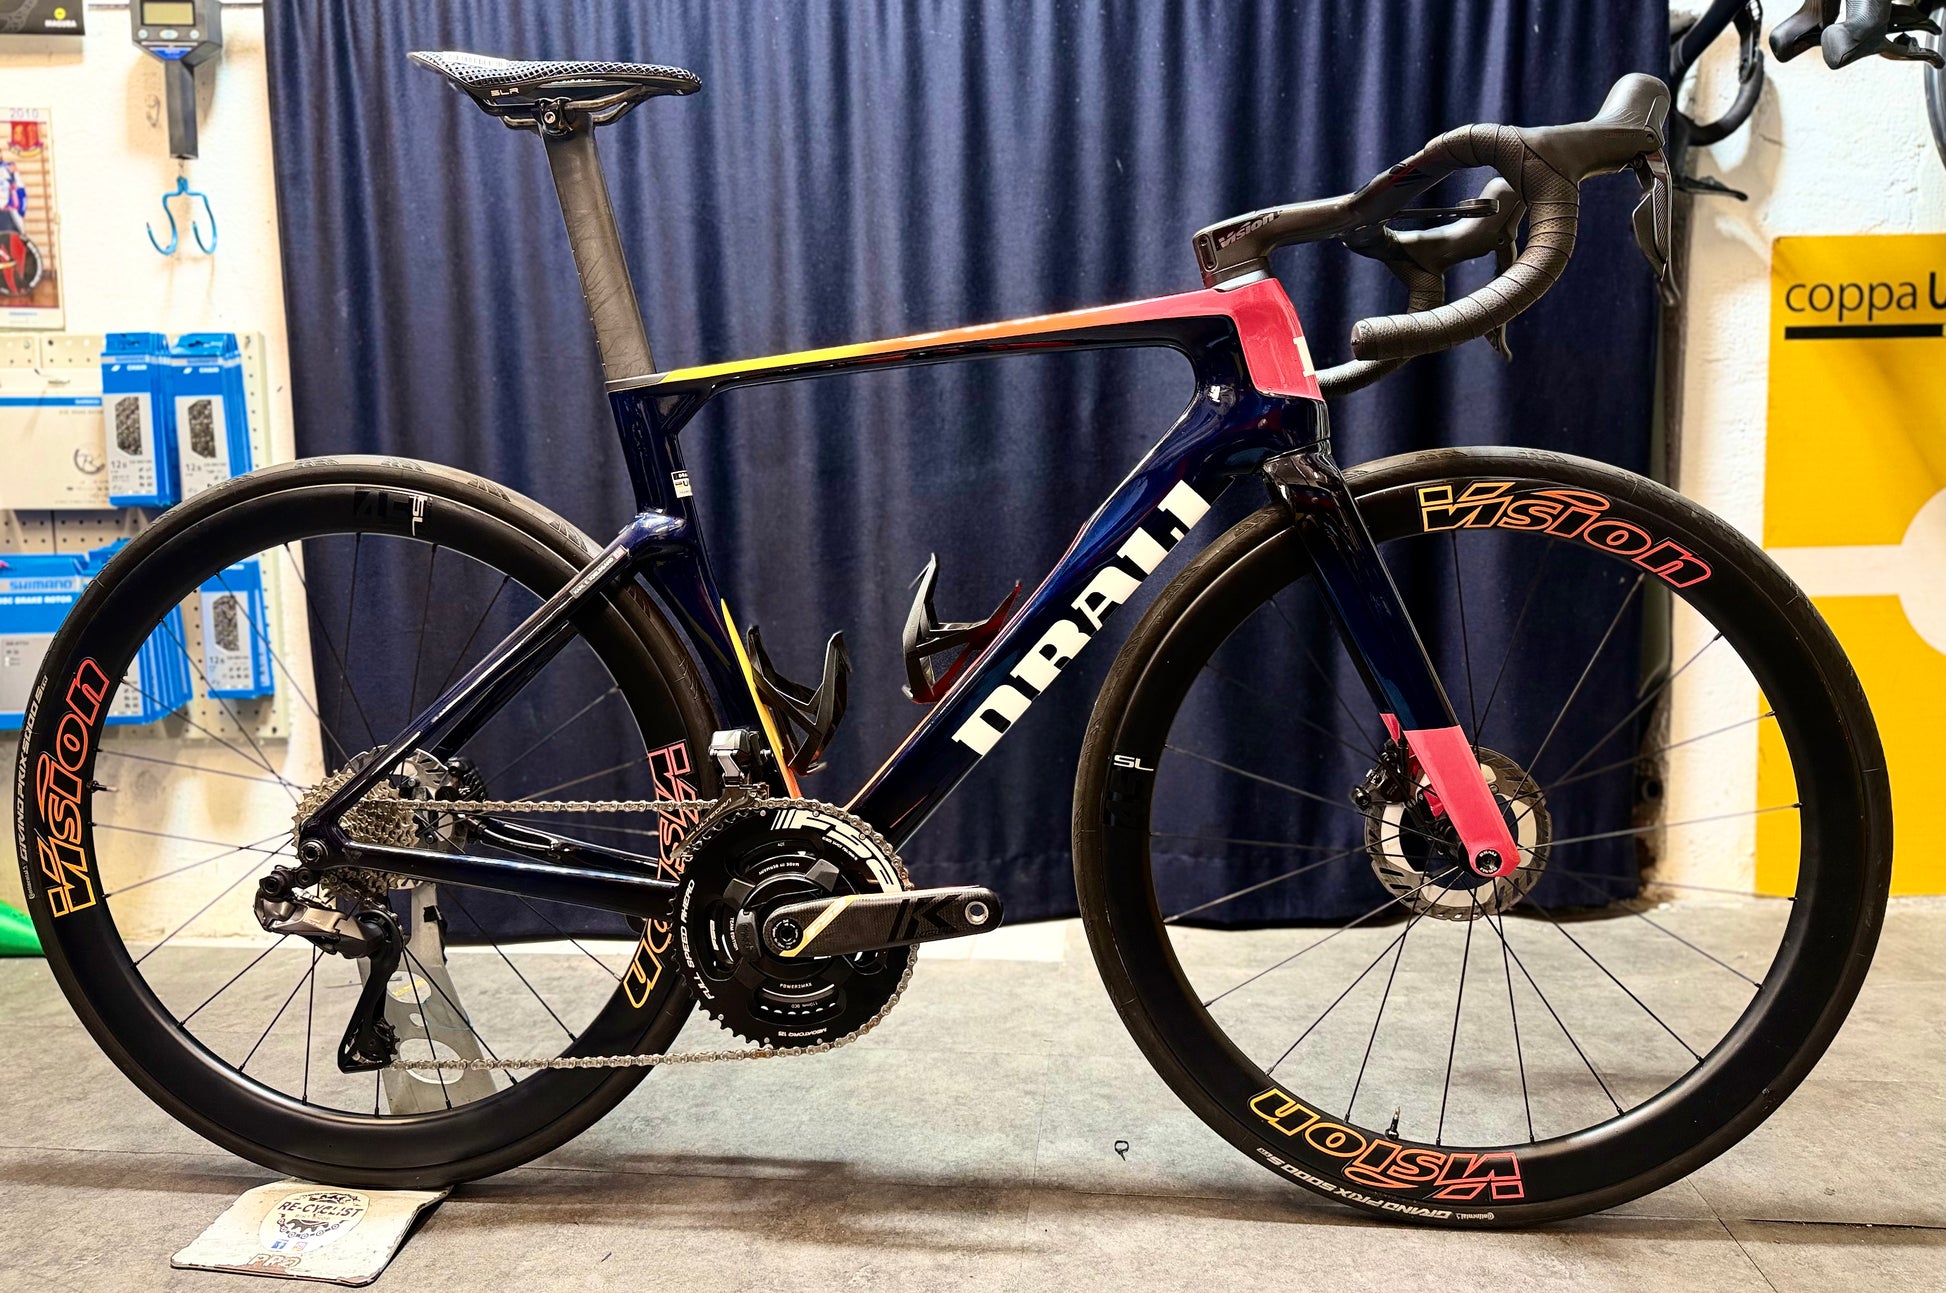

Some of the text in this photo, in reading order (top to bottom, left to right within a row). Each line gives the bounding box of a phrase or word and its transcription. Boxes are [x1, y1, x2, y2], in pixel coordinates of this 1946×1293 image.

[490, 88, 519, 97] SLR
[10, 108, 39, 119] 2010
[1785, 281, 1918, 323] coppa
[9, 578, 73, 591] SHIMANO
[15, 595, 43, 605] BRAKE
[44, 594, 73, 604] ROTOR
[21, 706, 39, 755] 5000
[1112, 753, 1155, 772] SL
[17, 757, 29, 800] PRIX
[695, 797, 733, 832] ULTEGRA
[17, 801, 29, 862] GRAND
[680, 879, 715, 1000] FULL SPEED AHEAD
[1280, 1163, 1338, 1193] 5000
[1333, 1186, 1385, 1208] PRIX
[277, 1201, 364, 1219] RE-CYCLIST
[1381, 1201, 1454, 1220] GRAND
